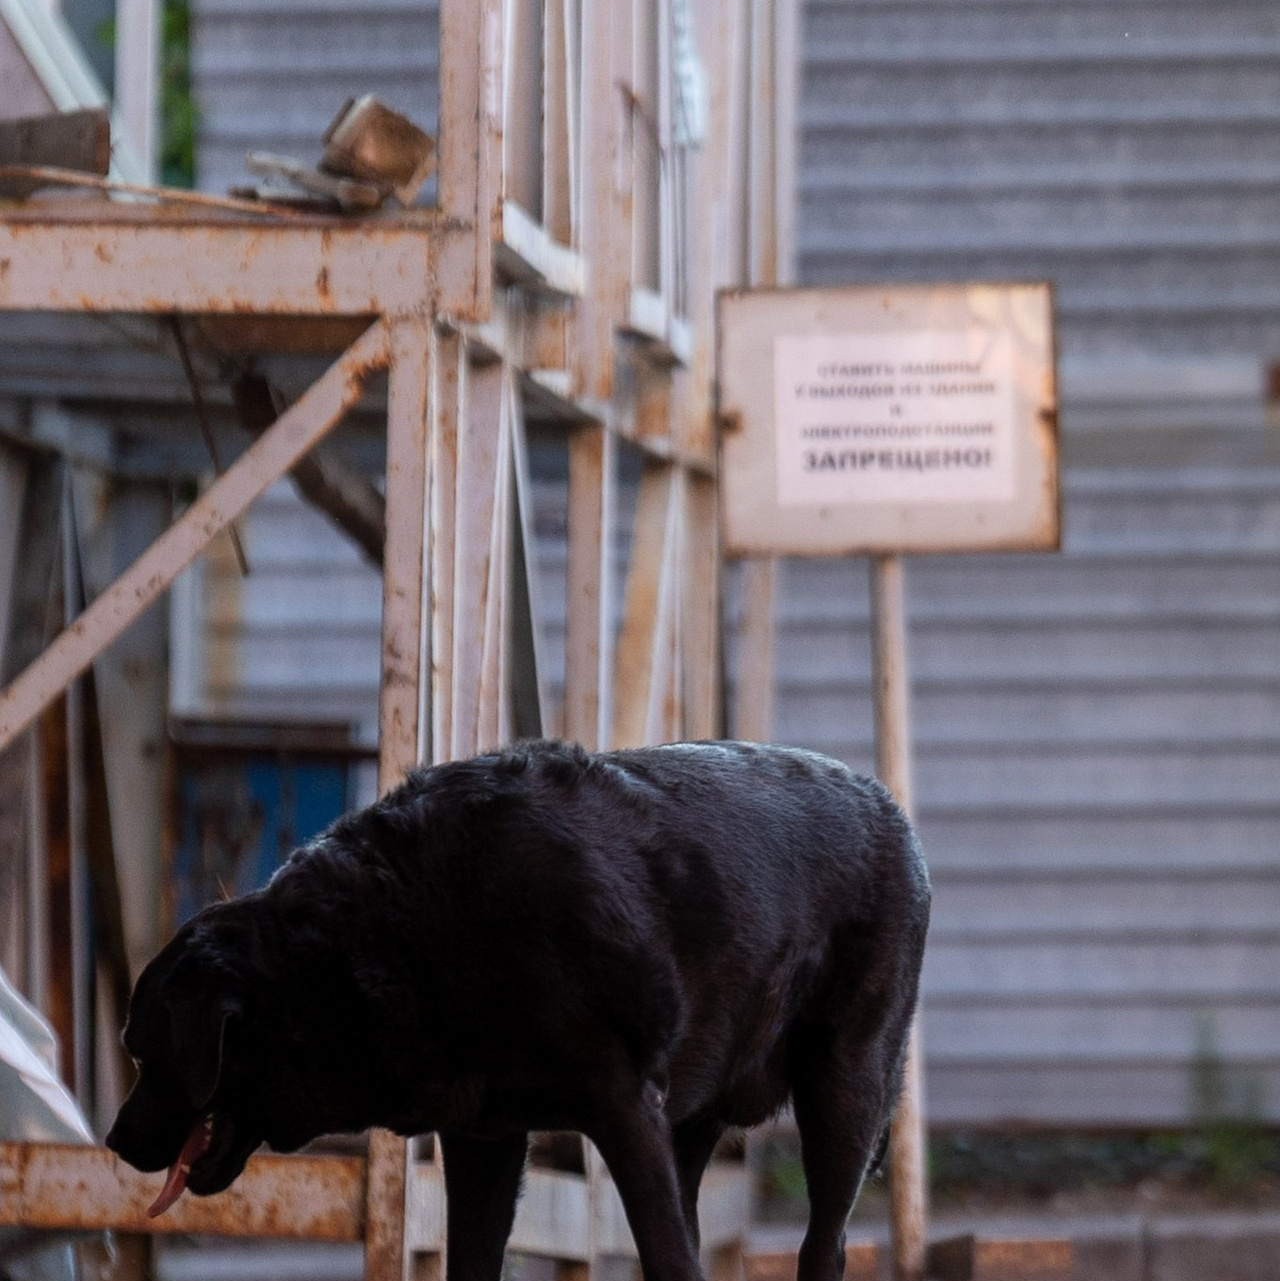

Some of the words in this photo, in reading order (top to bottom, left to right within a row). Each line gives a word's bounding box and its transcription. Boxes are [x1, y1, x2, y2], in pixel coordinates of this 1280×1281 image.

[817, 361, 895, 376] СТАВИТЬ
[900, 360, 981, 375] МАШИНЫ
[808, 383, 895, 399] ВЫХОДОВ
[804, 448, 991, 473] ЗАПРЕЩЕНО!
